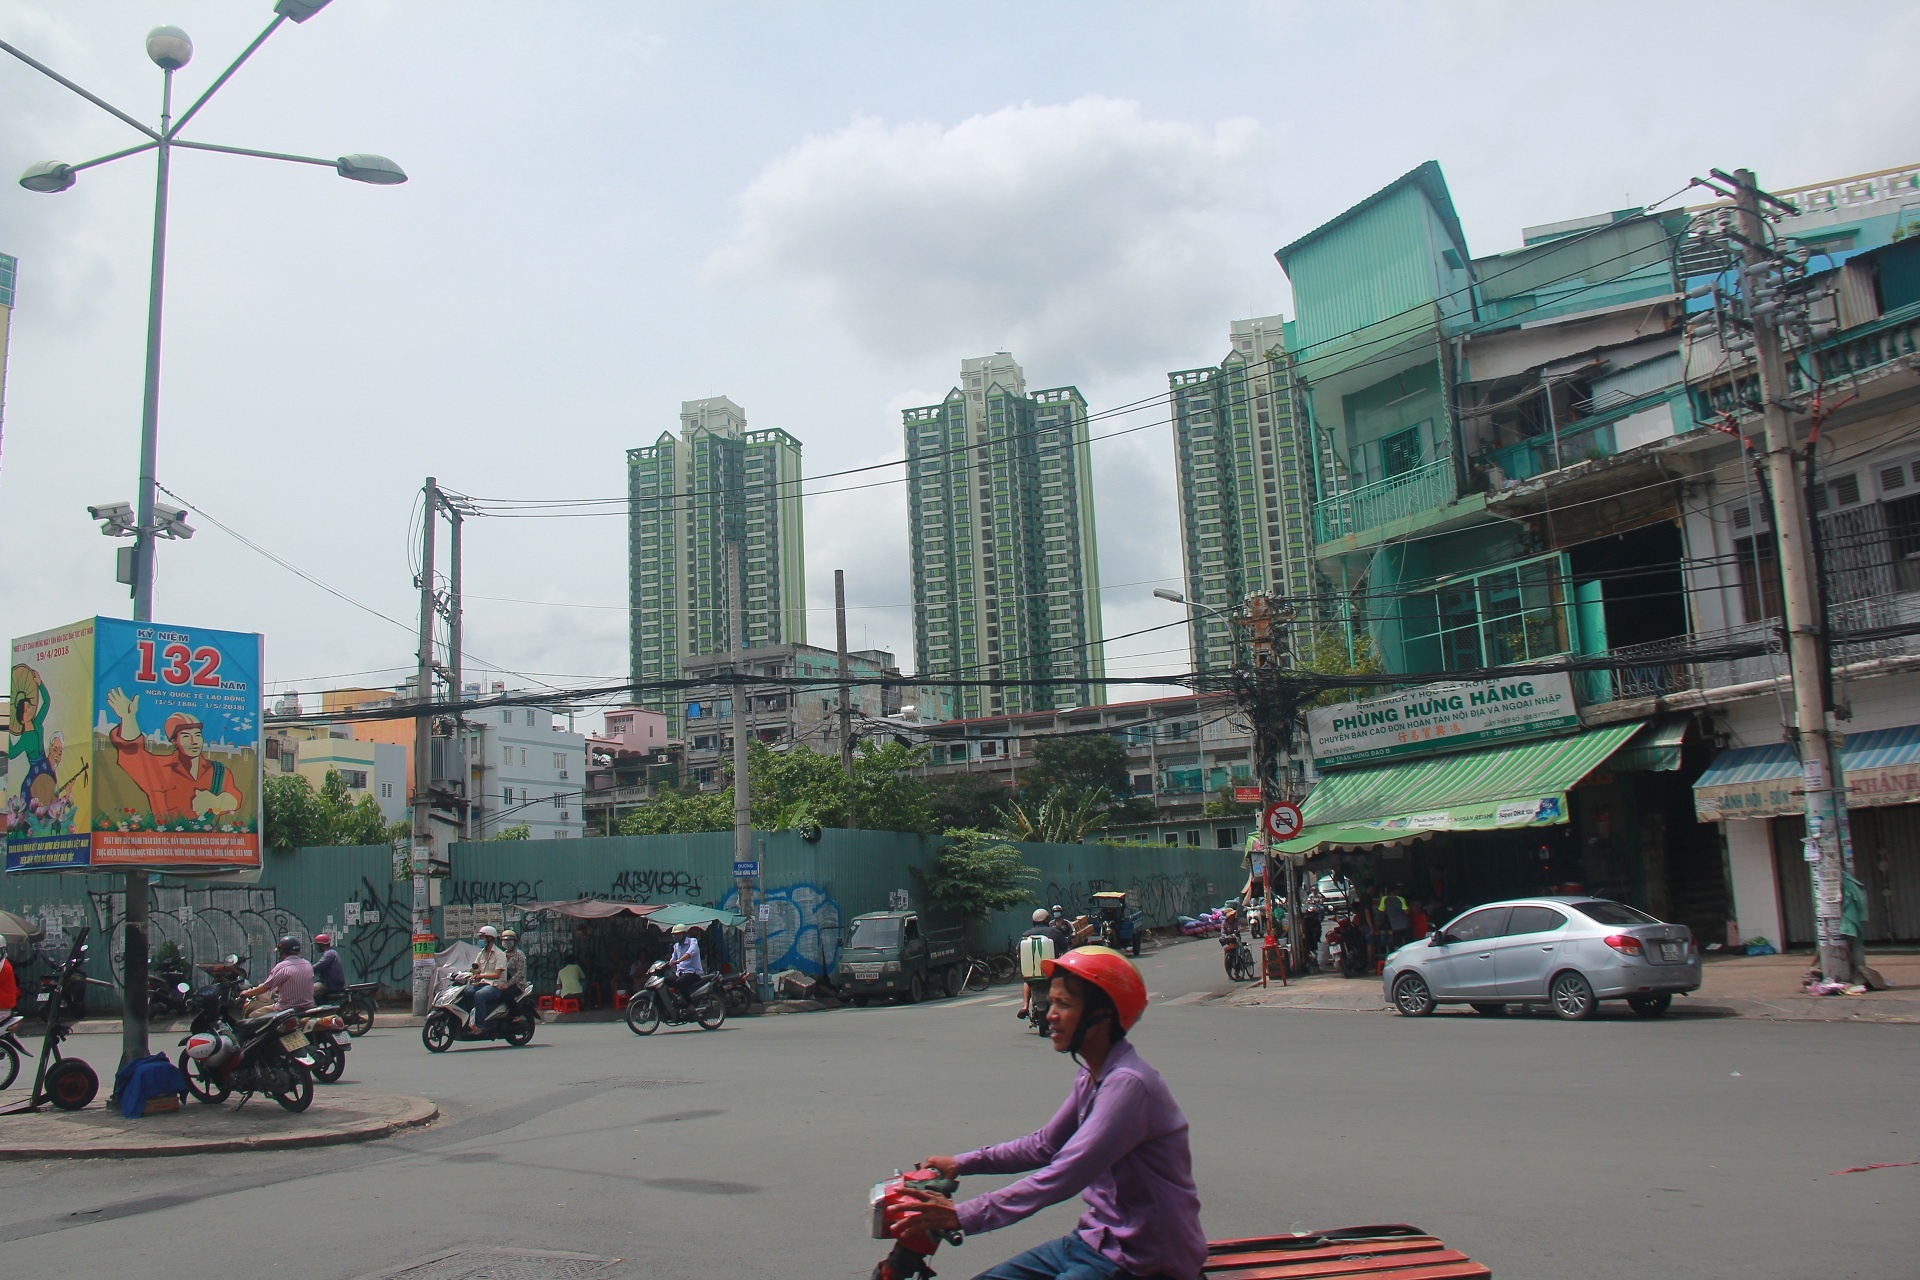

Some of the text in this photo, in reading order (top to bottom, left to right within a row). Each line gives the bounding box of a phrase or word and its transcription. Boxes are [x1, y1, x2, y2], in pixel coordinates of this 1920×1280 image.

[158, 631, 189, 642] NIỆM
[36, 645, 70, 661] 19/4/2018
[136, 640, 221, 687] 132
[220, 681, 246, 691] NĂM
[223, 694, 246, 703] ĐỘNG
[1332, 681, 1534, 732] PHÙNG HƯNG HÃNG
[1319, 732, 1350, 745] CHUYÊN
[1351, 728, 1368, 739] BÁN
[1369, 726, 1387, 736] CAO
[1388, 722, 1406, 732] ĐƠN
[1407, 716, 1431, 729] HOÀN
[1452, 710, 1468, 721] NỘI
[1470, 708, 1485, 719] ĐỊA
[1487, 704, 1500, 714] VÀ
[1502, 698, 1532, 712] NGOẠI
[1534, 693, 1562, 706] NHẬP
[1352, 751, 1370, 759] HƯNG
[414, 942, 428, 951] 179
